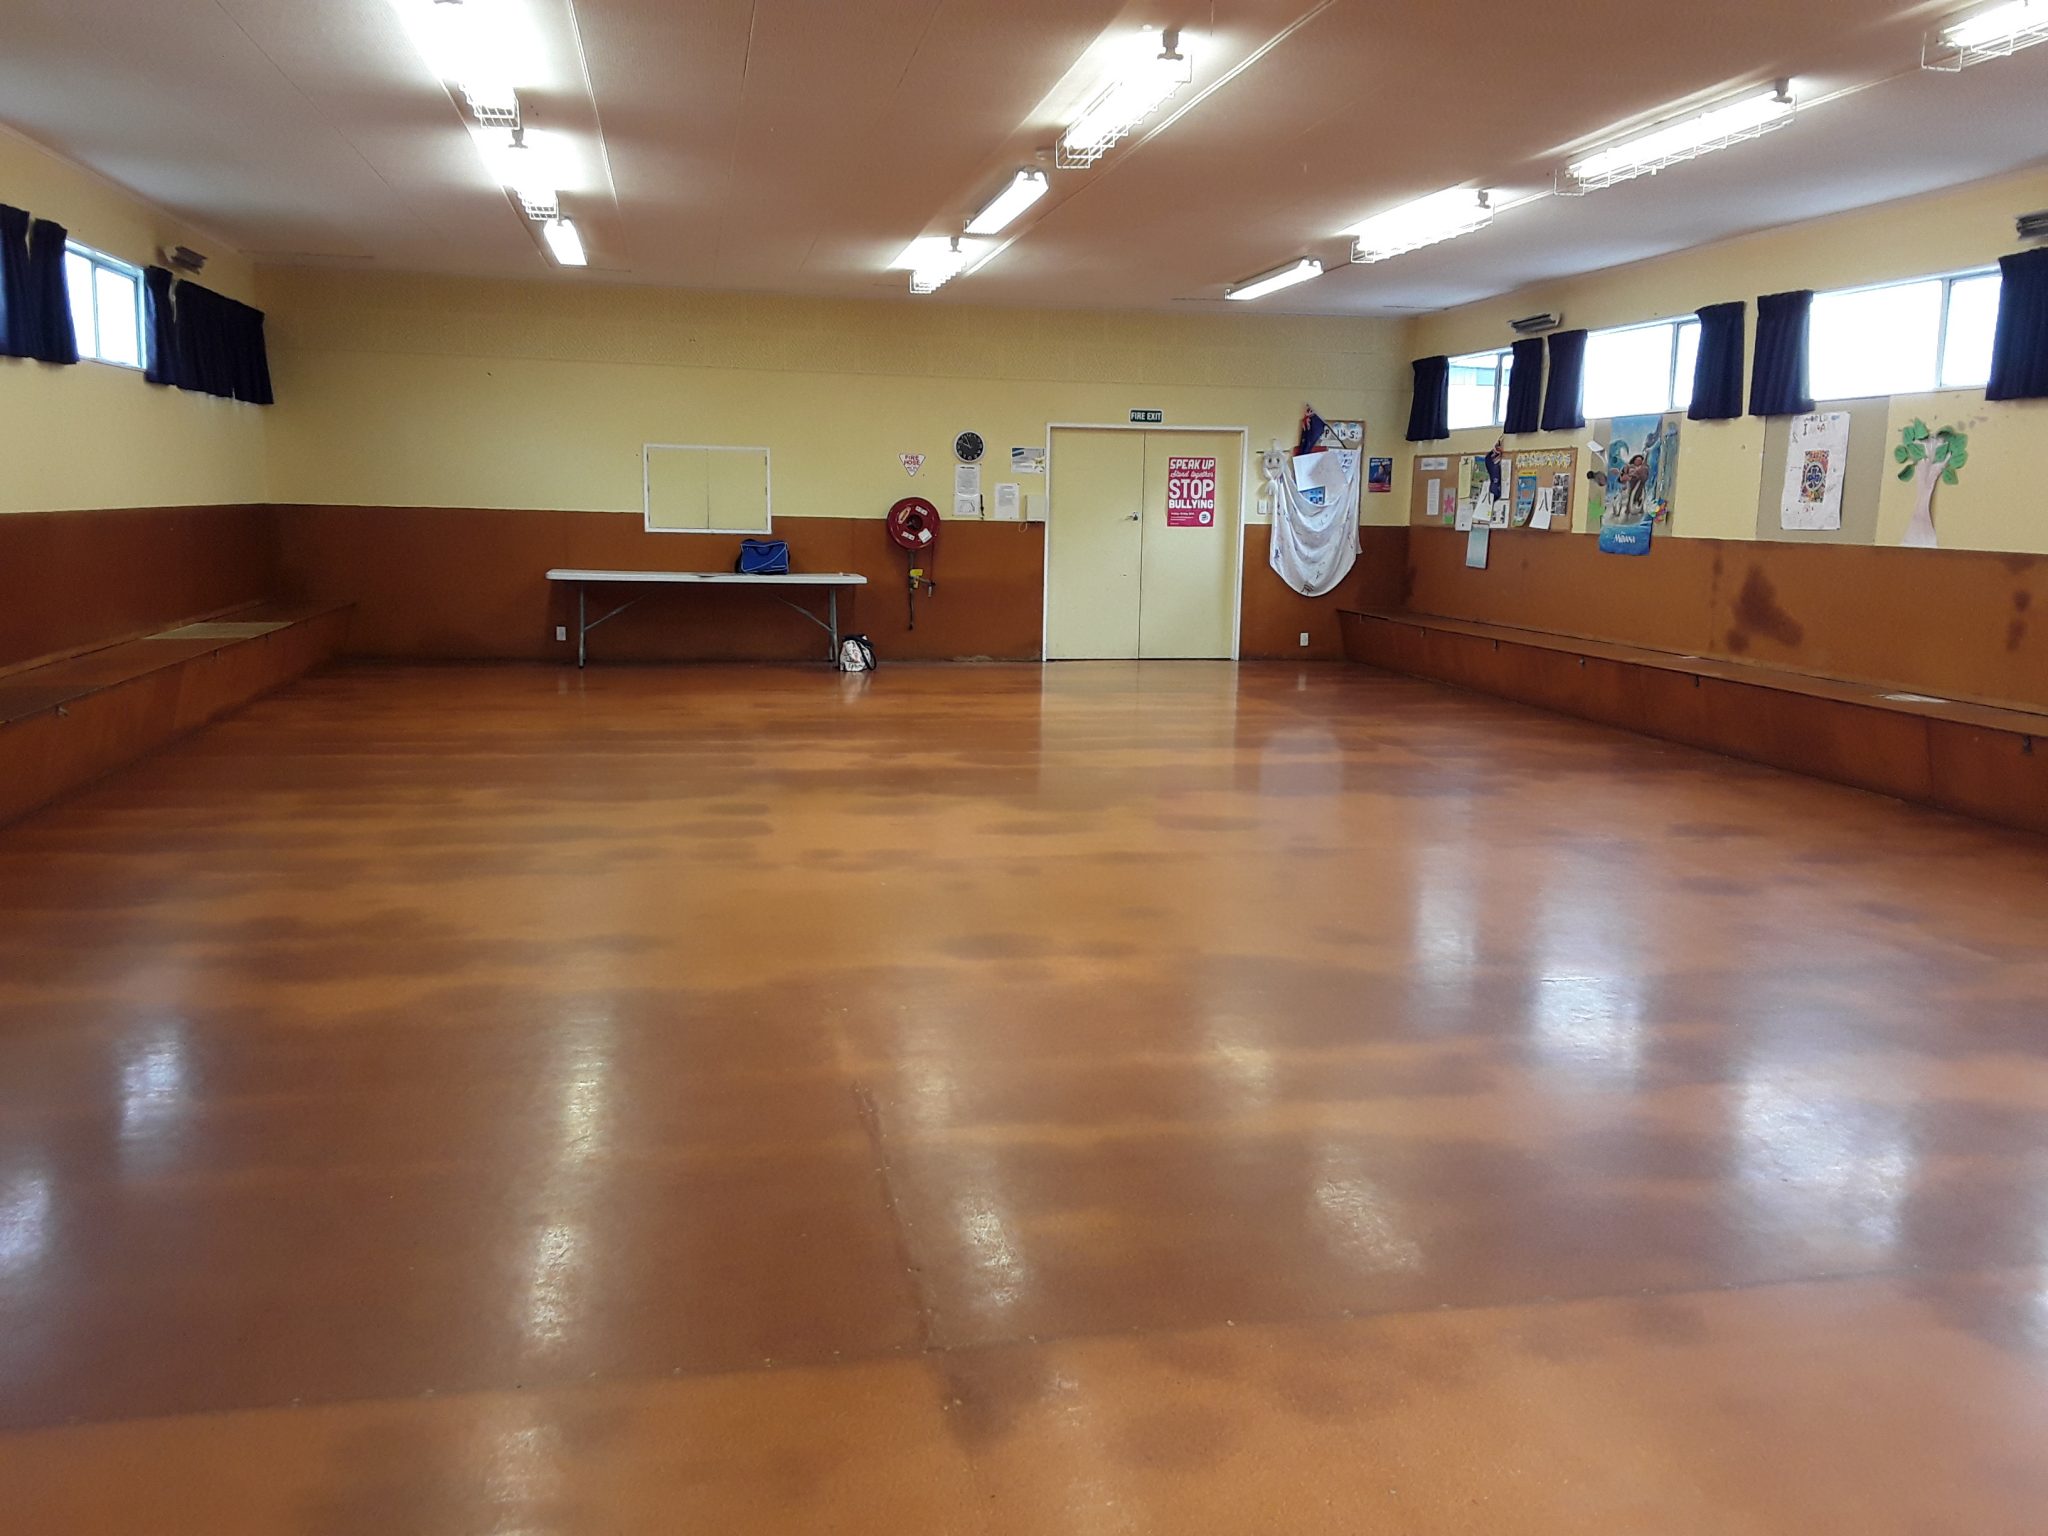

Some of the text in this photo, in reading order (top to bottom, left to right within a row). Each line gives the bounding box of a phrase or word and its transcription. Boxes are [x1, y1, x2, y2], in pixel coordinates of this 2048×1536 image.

[1131, 412, 1161, 420] FIRE EXIT
[1170, 459, 1214, 469] SPEAK UP
[1169, 479, 1214, 499] STOP
[1169, 500, 1213, 508] BULLYING
